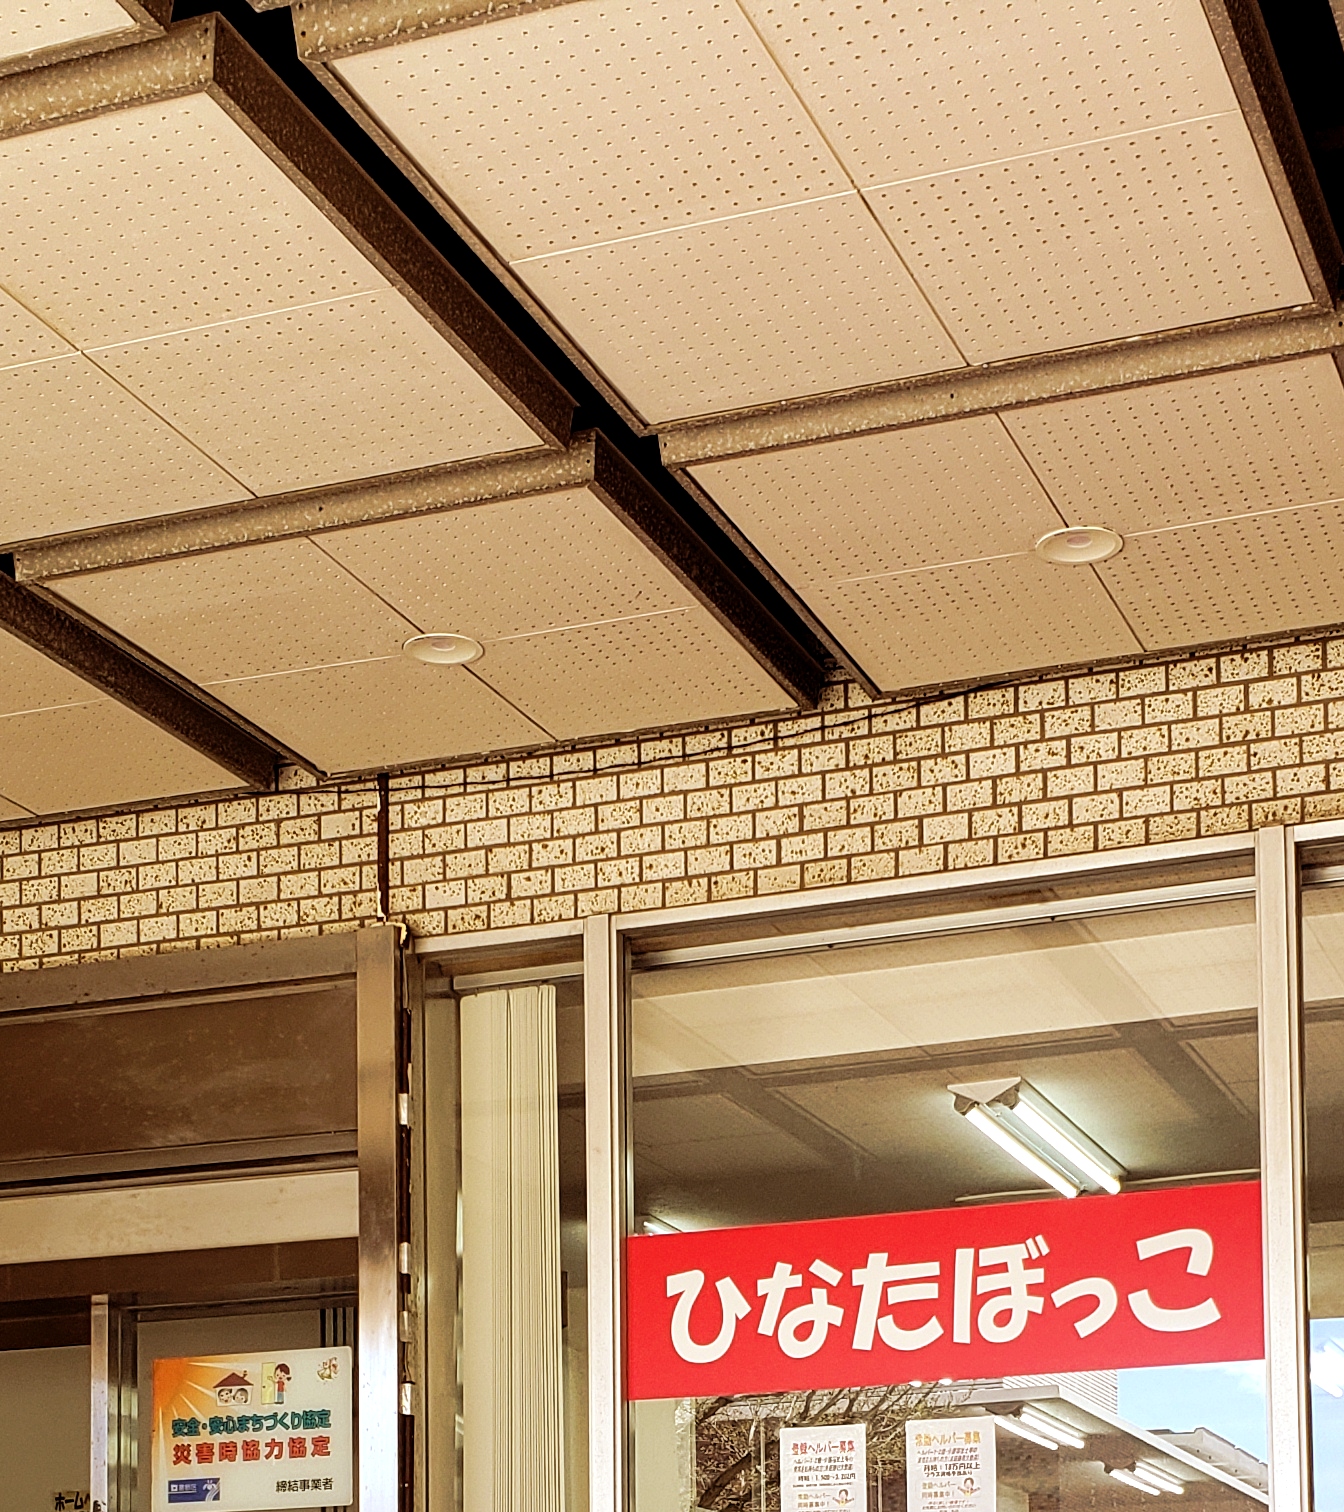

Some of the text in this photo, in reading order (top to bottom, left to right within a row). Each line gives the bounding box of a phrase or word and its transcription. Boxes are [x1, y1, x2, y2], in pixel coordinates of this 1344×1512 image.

[665, 1228, 1223, 1364] ひなたぼっこ
[172, 1409, 332, 1438] 安全・安心まちづくり協定
[172, 1435, 331, 1466] 災害時協力協定
[275, 1477, 334, 1493] 締結事業者
